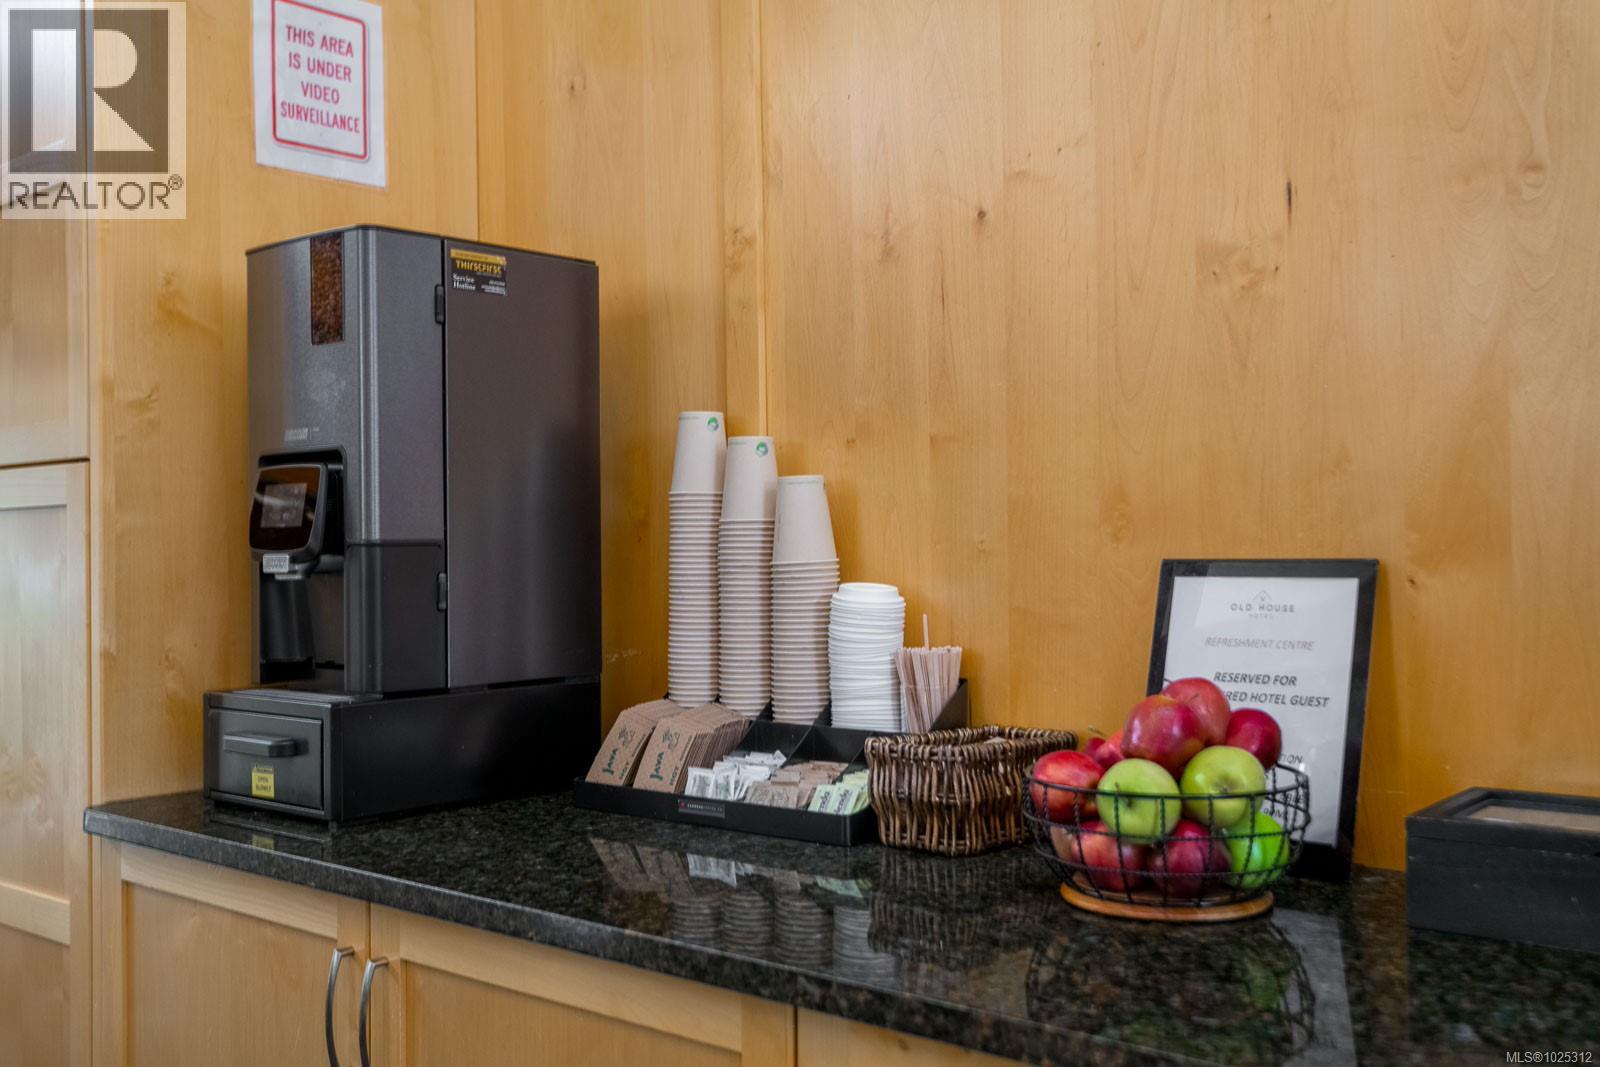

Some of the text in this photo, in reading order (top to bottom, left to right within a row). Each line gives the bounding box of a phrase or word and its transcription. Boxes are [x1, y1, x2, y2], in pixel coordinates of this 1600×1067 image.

[286, 25, 354, 58] THIS AREA
[289, 52, 352, 83] IS UNDER
[300, 80, 341, 105] VIDEO
[280, 101, 360, 134] SURVEILLANCE
[1230, 603, 1295, 613] OLD HOUSE
[1204, 636, 1315, 651] REFRESHMENT CENTRE
[1213, 671, 1298, 687] RESERVED FOR
[1249, 691, 1287, 705] HOTEL
[1289, 695, 1330, 708] GUEST
